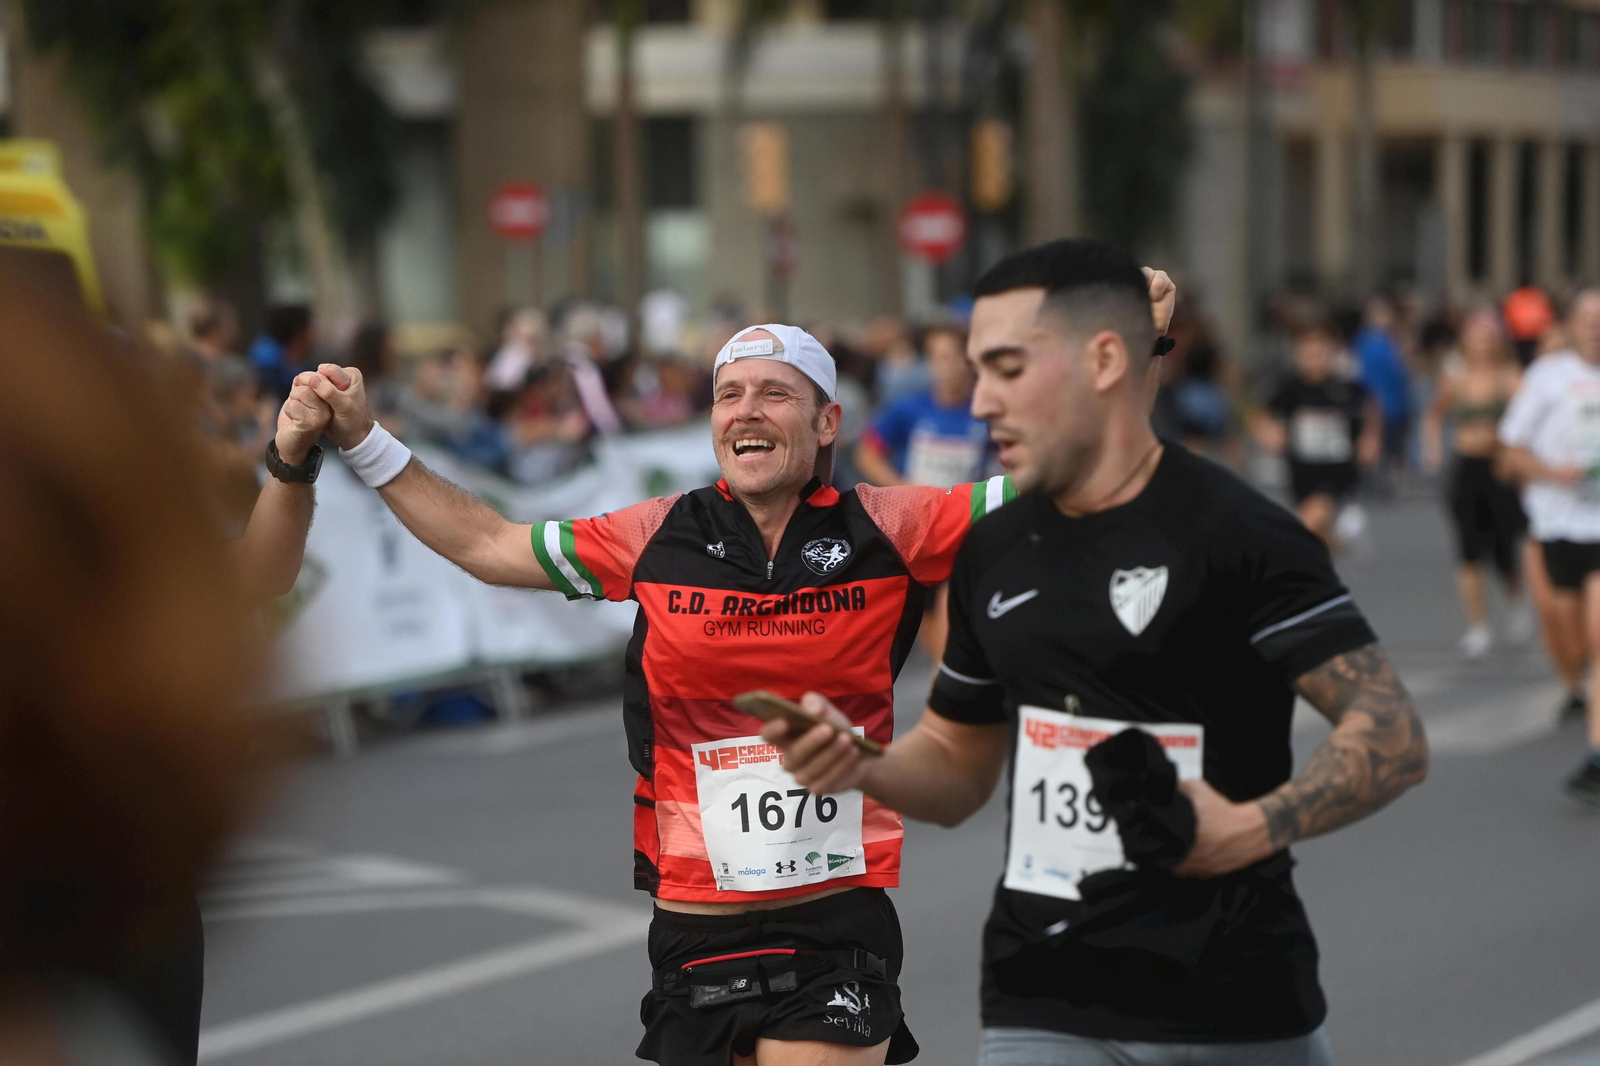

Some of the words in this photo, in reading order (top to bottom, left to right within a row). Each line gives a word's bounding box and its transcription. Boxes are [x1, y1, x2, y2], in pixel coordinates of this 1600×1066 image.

[668, 590, 711, 615] C.D.
[721, 586, 866, 616] ARCHIDONA
[703, 620, 742, 636] GYM
[747, 619, 826, 636] RUNNING
[698, 746, 739, 771] 42
[739, 755, 772, 765] CIUDAD
[731, 788, 838, 833] 1676
[823, 1012, 871, 1037] Sevilla
